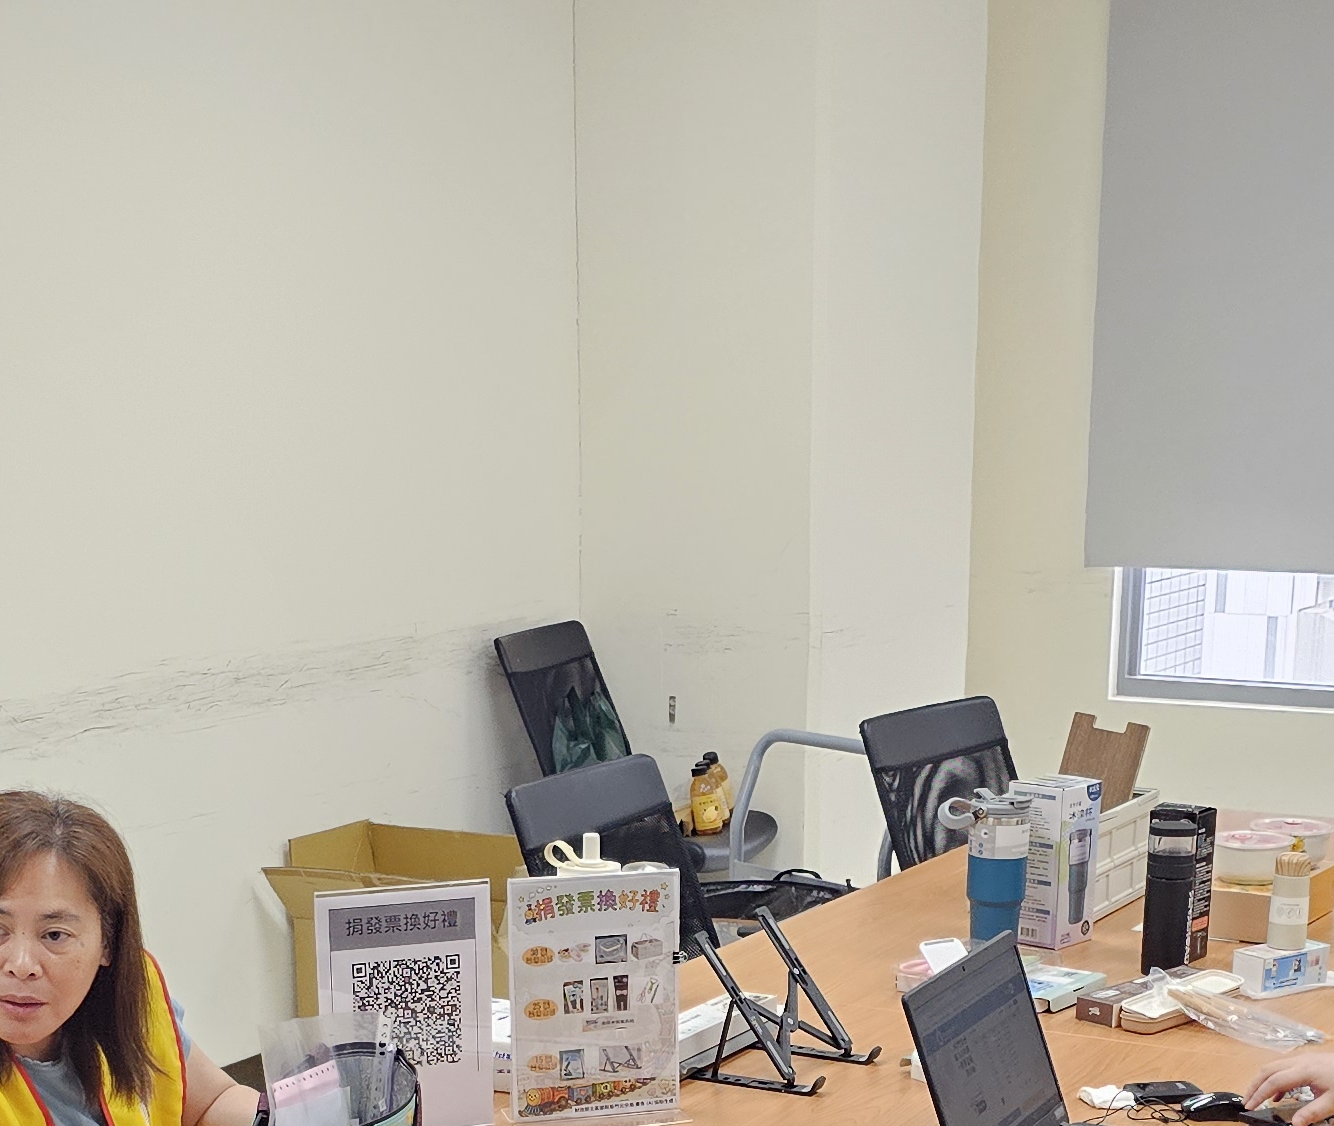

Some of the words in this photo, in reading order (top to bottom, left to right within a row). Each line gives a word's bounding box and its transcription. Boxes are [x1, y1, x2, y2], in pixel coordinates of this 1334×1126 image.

[534, 889, 660, 921] 捐發票換好禮
[345, 909, 458, 937] 捐發票換好禮
